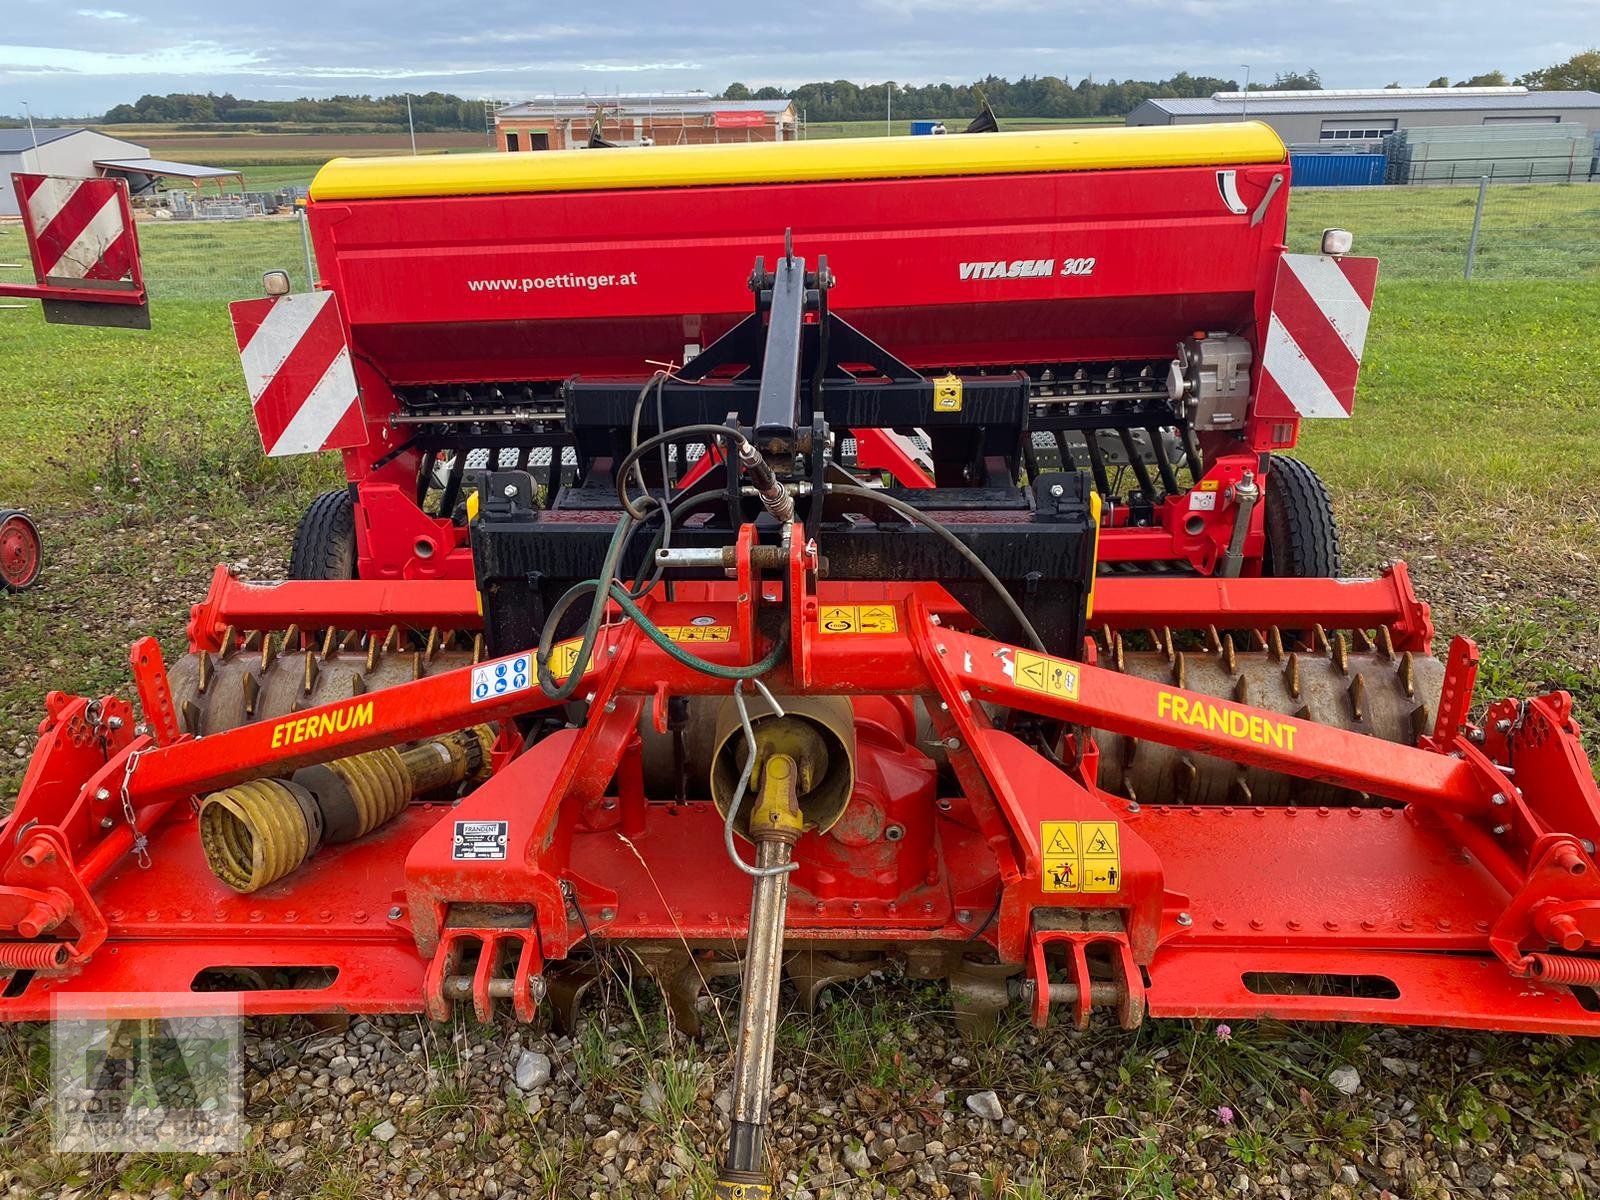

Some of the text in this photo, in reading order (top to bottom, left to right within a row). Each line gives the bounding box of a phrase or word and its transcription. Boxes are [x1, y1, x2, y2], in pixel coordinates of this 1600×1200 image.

[467, 271, 638, 293] www.poettinger.at
[959, 257, 1096, 280] VITASEM 302
[271, 701, 374, 749] ETERNUM
[1157, 691, 1298, 751] FRANDENT
